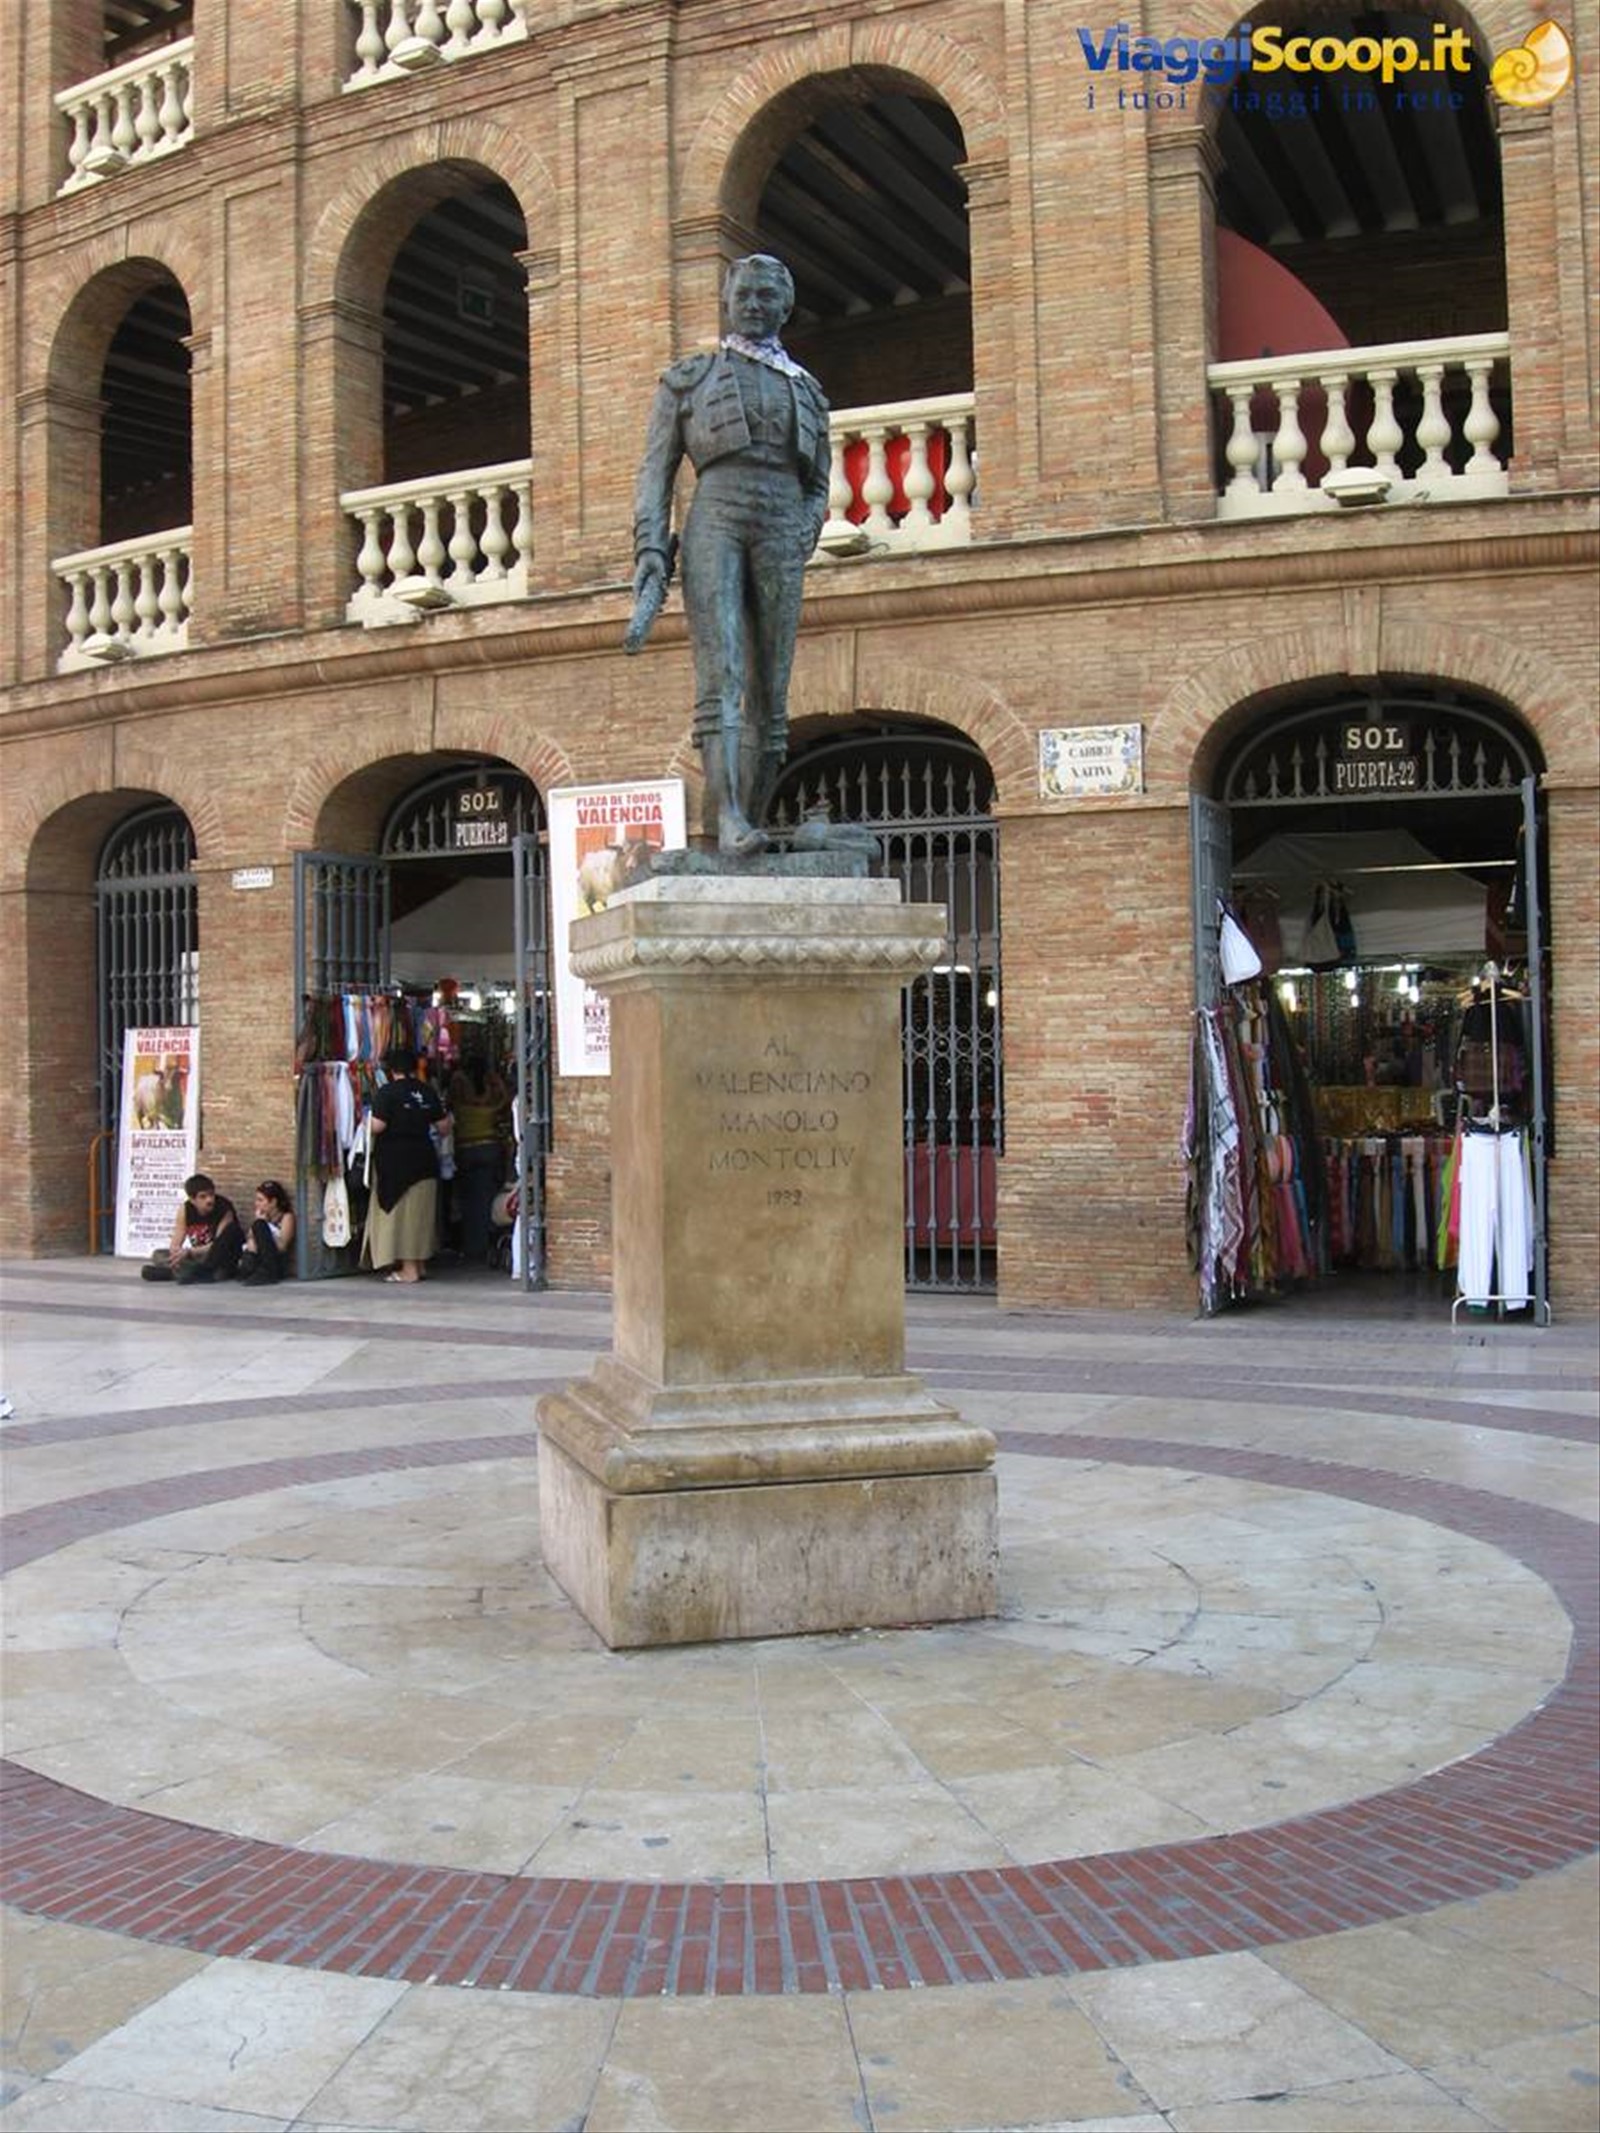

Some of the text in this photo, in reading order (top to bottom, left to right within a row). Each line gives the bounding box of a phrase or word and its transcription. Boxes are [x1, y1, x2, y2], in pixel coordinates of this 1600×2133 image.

[1347, 727, 1403, 749] SOL
[460, 791, 499, 812] SOL
[576, 792, 662, 807] PLAZA DE TOROS
[577, 805, 663, 825] VALENCIA
[137, 1039, 191, 1053] VALENCIA
[763, 1034, 795, 1057] AL
[695, 1070, 872, 1095] VALENCIANO
[720, 1109, 839, 1133] MANOLO
